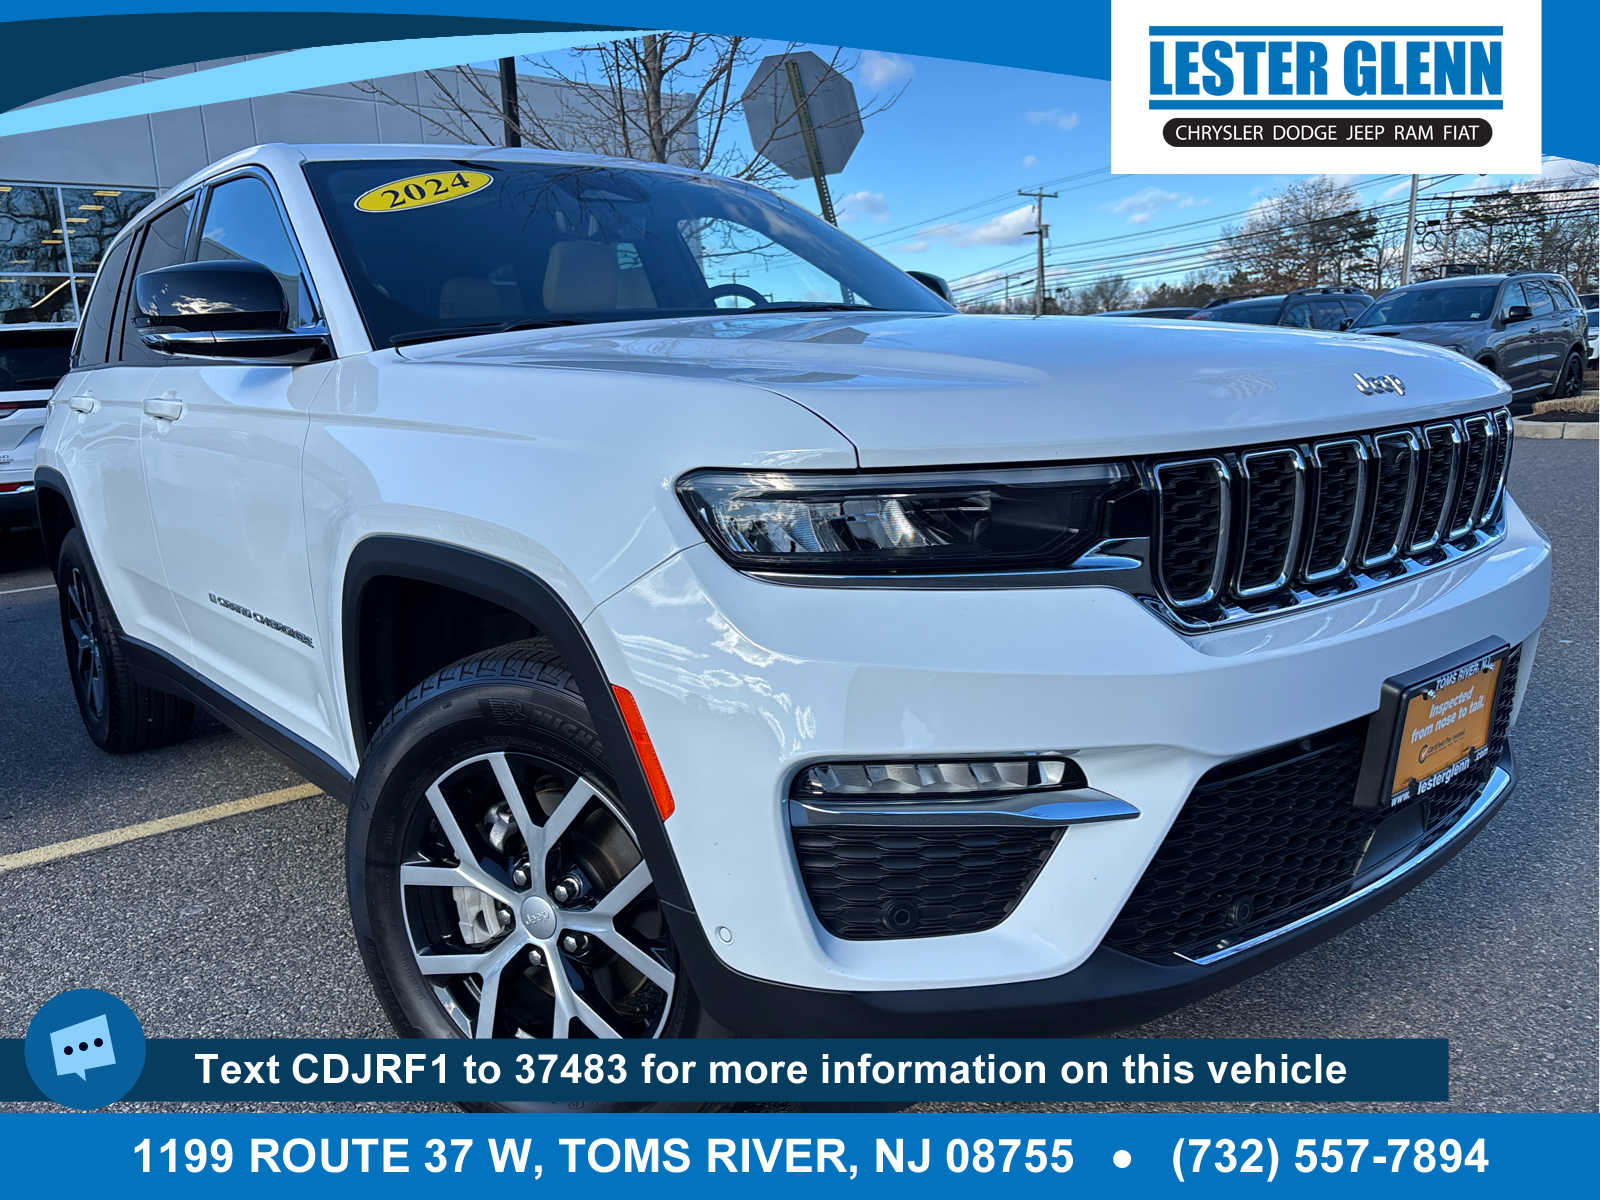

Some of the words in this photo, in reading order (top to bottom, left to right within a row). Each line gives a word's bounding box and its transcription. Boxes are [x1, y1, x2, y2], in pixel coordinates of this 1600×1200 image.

[380, 172, 470, 208] 2024
[1353, 372, 1405, 396] Jeep
[1436, 670, 1458, 691] TOMS
[1429, 685, 1474, 719] Inspected
[1411, 724, 1434, 744] from
[1434, 712, 1457, 732] nose
[1457, 706, 1468, 720] to
[1418, 757, 1470, 795] lesterglenn
[525, 911, 551, 926] Jeep
